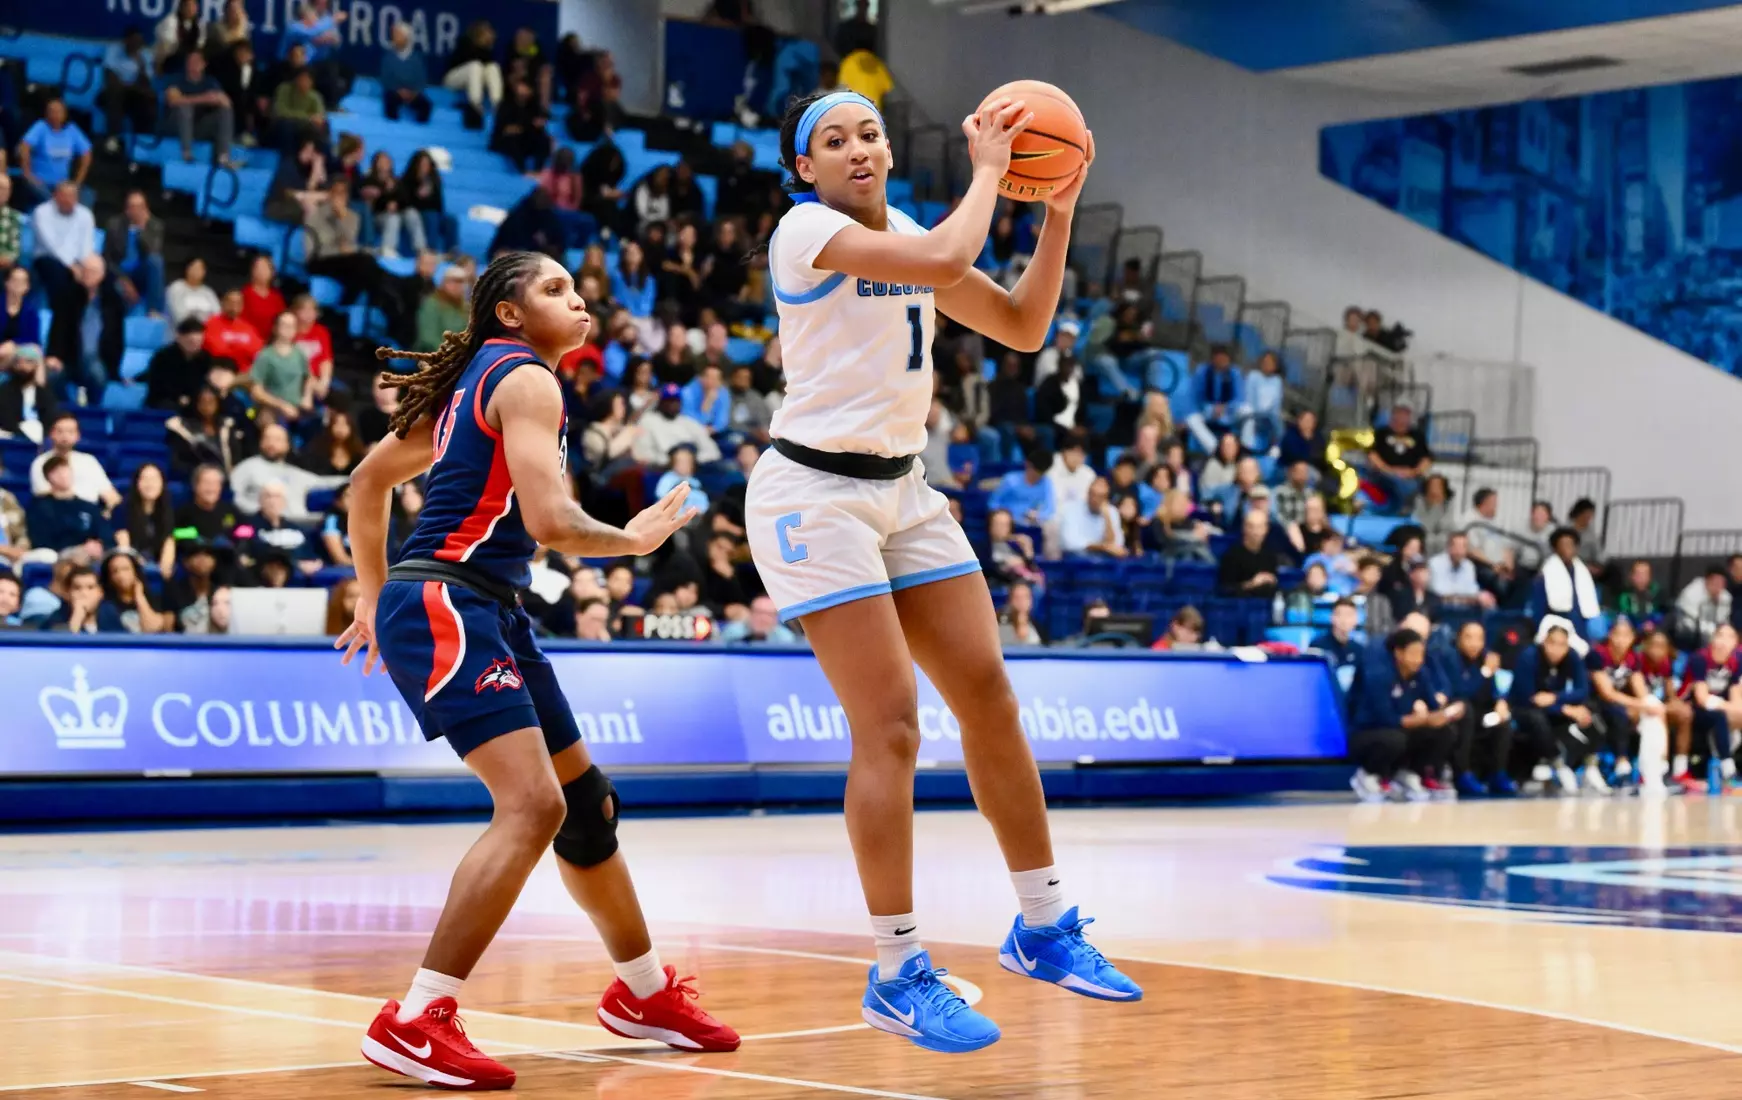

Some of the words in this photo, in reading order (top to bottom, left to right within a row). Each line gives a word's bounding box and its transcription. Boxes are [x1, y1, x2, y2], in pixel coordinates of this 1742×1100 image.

[905, 303, 924, 373] 1
[775, 511, 809, 565] C
[643, 614, 695, 639] POSS
[152, 693, 424, 747] COLUMBI
